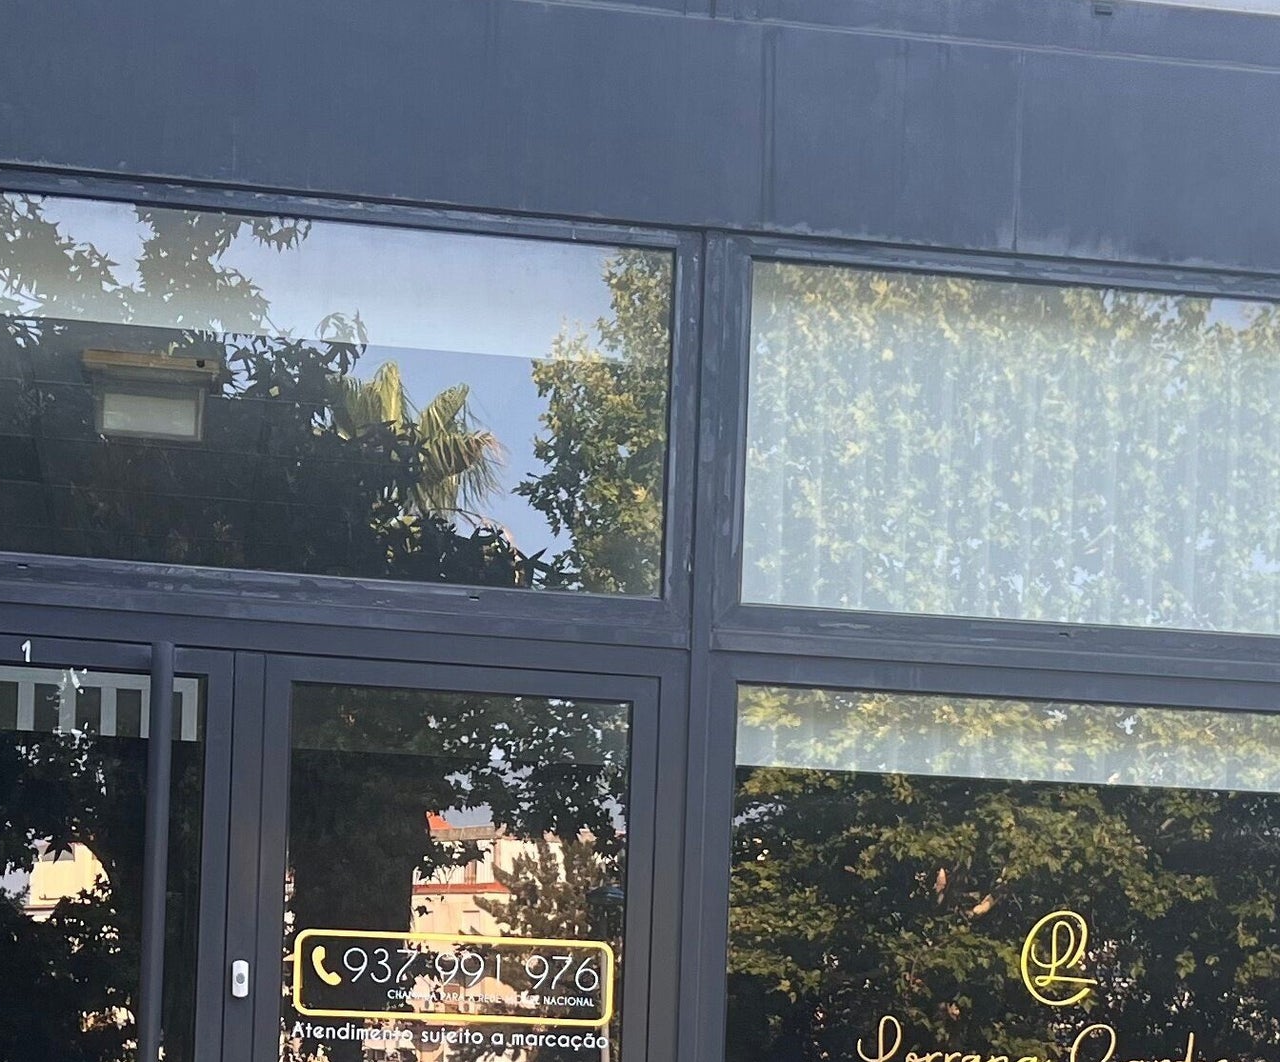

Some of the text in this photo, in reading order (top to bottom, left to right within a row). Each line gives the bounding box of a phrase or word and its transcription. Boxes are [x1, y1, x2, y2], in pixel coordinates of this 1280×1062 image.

[21, 640, 31, 663] 1
[342, 947, 600, 992] 937 991 976
[543, 995, 596, 1007] NACIONAL
[291, 1021, 609, 1052] Atendimento sujeito a marcação
